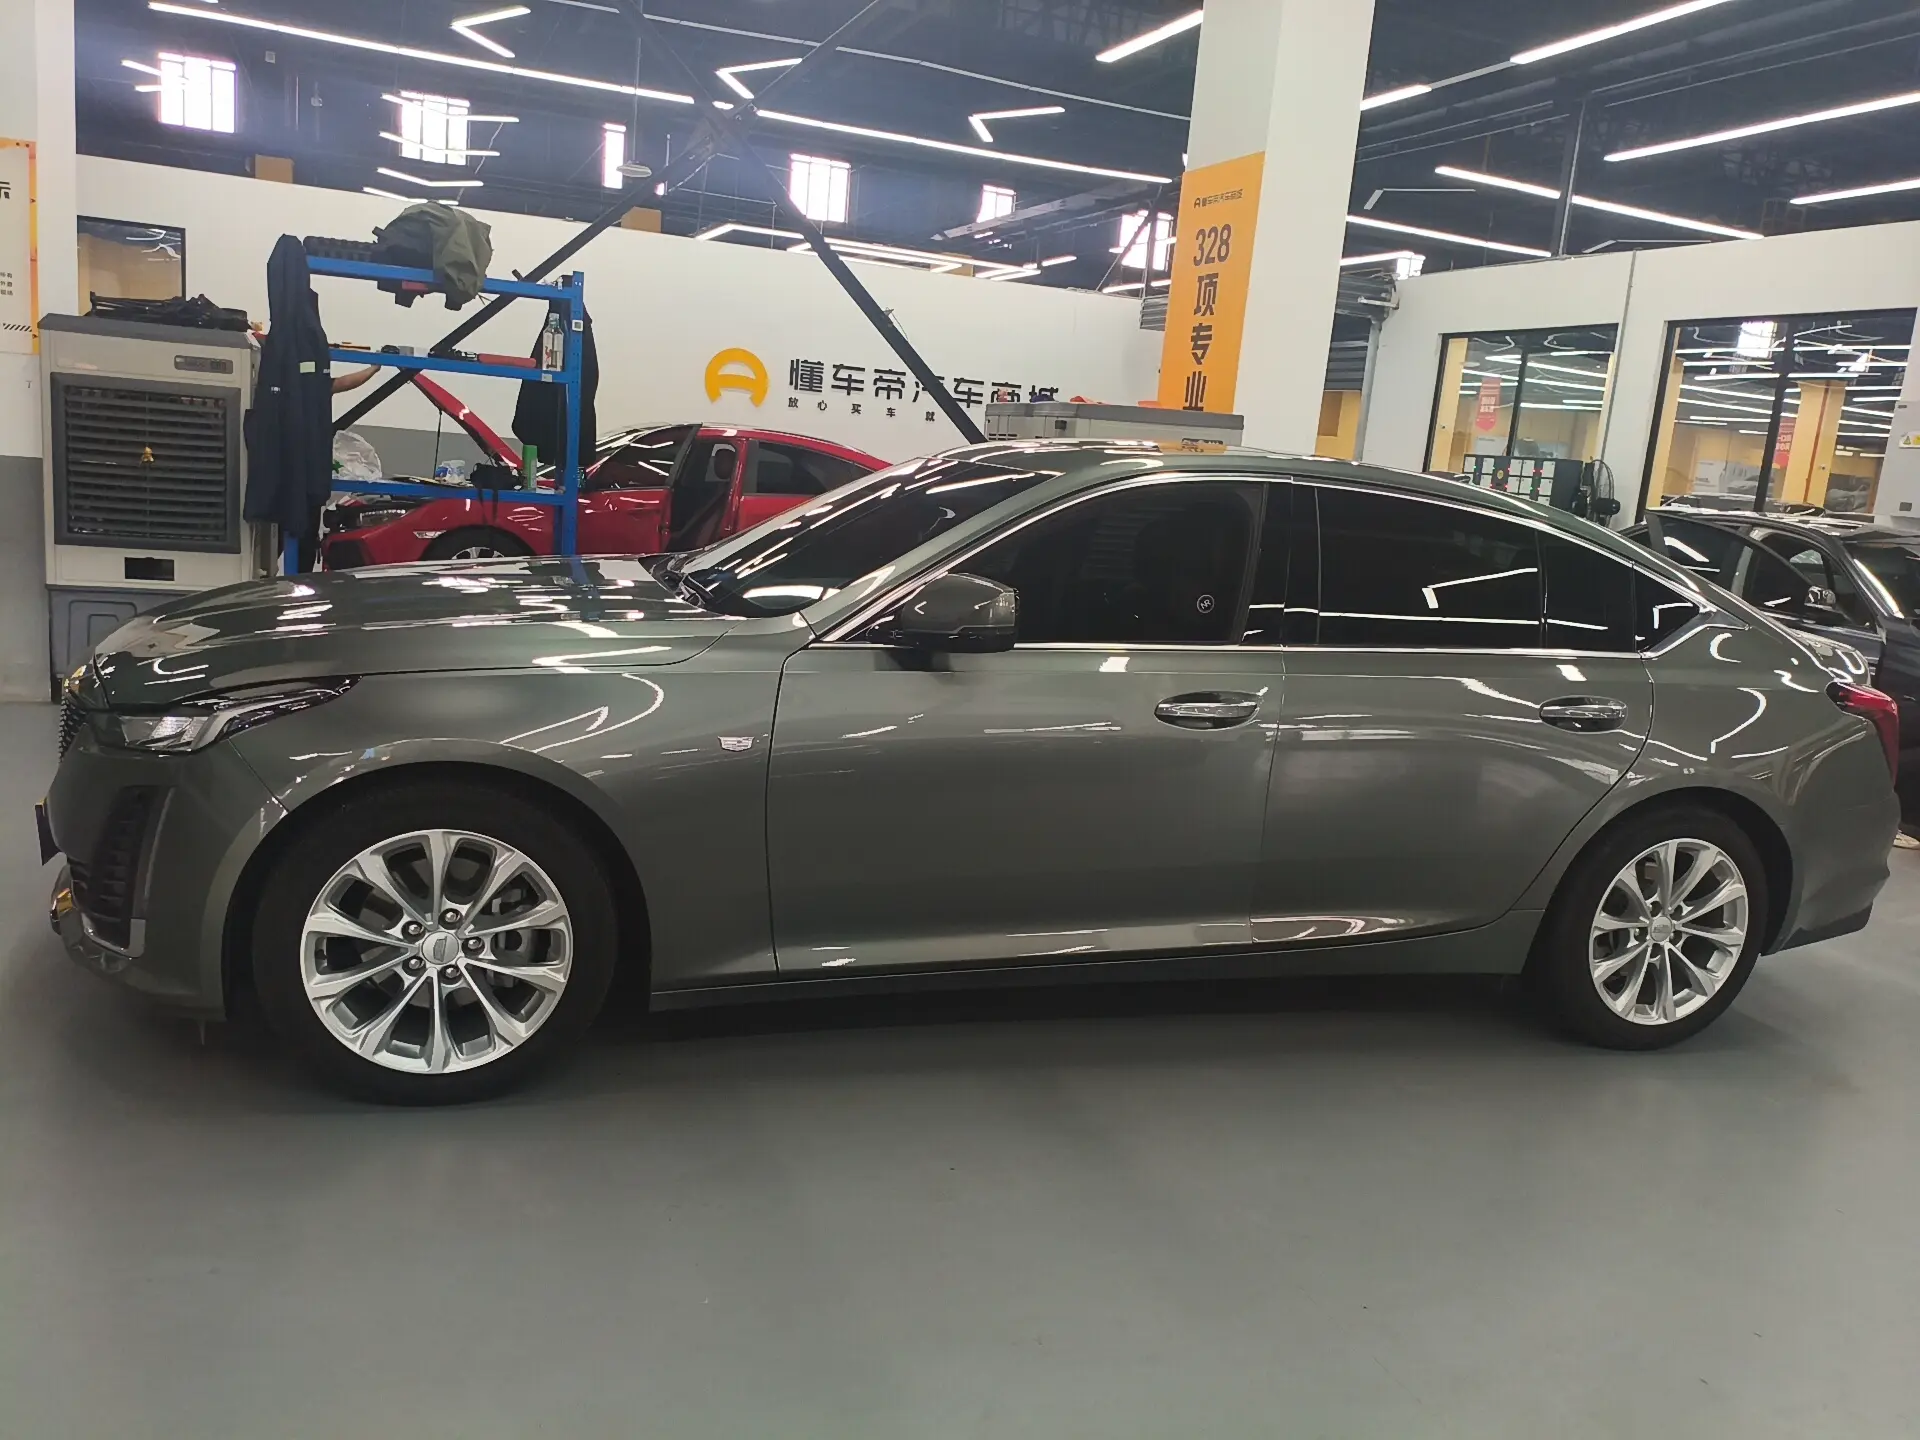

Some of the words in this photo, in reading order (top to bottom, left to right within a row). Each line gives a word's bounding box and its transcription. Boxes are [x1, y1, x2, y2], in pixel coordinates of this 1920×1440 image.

[1193, 223, 1232, 267] 328
[1182, 272, 1219, 412] 项专业
